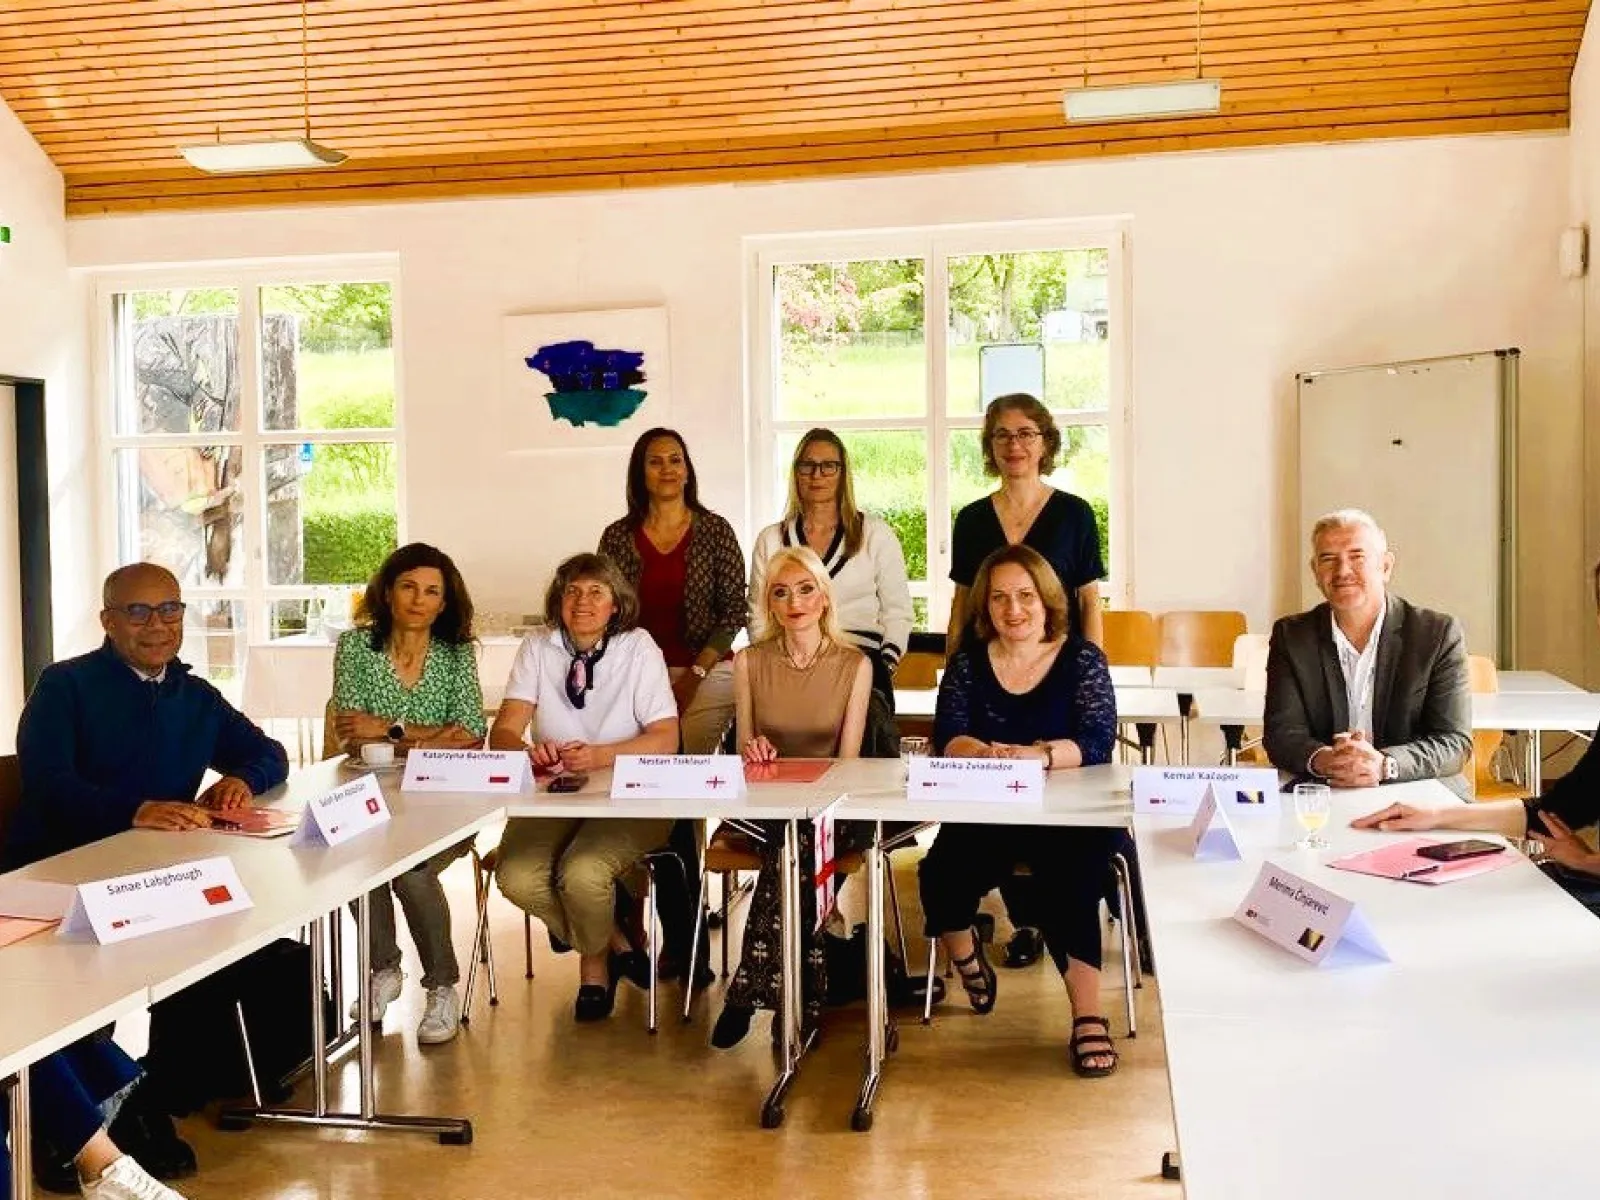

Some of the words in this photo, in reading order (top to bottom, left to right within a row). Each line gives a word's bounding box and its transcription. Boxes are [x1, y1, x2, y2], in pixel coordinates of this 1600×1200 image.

[423, 752, 464, 760] Katarzyna
[638, 757, 670, 765] Nestan
[930, 760, 963, 769] Marika
[1163, 771, 1195, 780] Kemal
[107, 881, 142, 896] Sanae
[143, 867, 203, 888] Labghough
